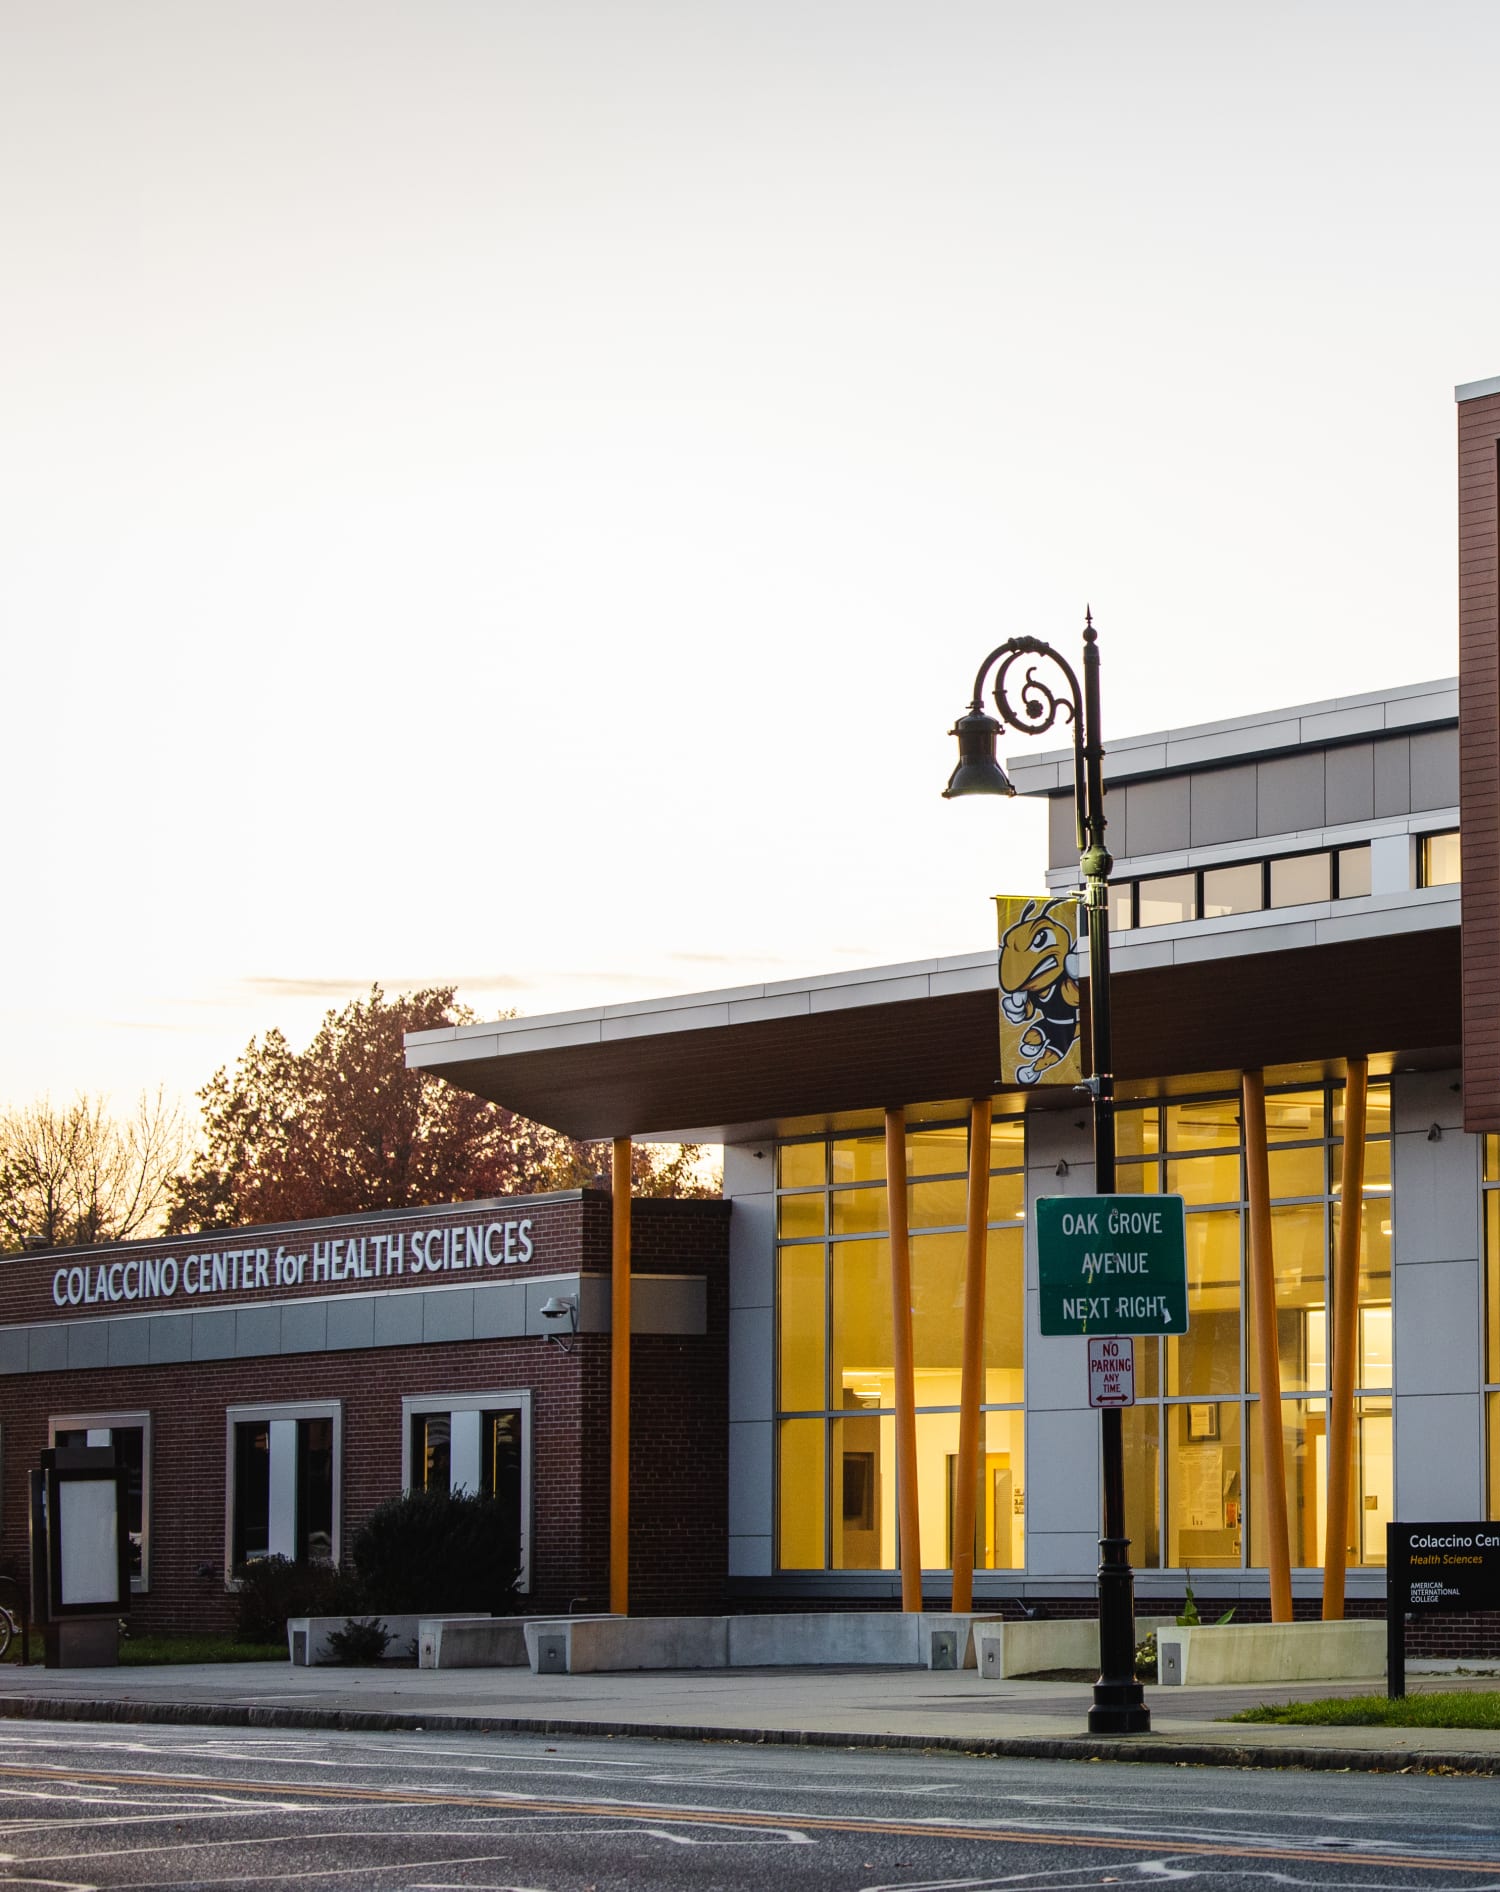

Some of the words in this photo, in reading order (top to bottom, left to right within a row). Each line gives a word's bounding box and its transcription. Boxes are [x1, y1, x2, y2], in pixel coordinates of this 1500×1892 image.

[1062, 1213, 1099, 1235] OAK
[1108, 1212, 1163, 1234] GROVE
[53, 1257, 179, 1306] COLACCINO
[183, 1248, 270, 1294] CENTER
[275, 1246, 308, 1285] for
[313, 1233, 405, 1282] HEALTH
[410, 1219, 534, 1274] SCIENCES
[1081, 1252, 1149, 1274] AVENUE
[1063, 1297, 1110, 1319] NEXT
[1118, 1296, 1166, 1318] RIGHT
[1102, 1343, 1119, 1356] NO
[1091, 1358, 1131, 1372] PARKING
[1103, 1373, 1120, 1382] ANY
[1103, 1384, 1121, 1393] TIME
[1409, 1534, 1473, 1548] Colaccino
[1410, 1555, 1441, 1565] Health
[1442, 1554, 1483, 1565] Sciences
[1410, 1588, 1461, 1596] INTERNATIONAL
